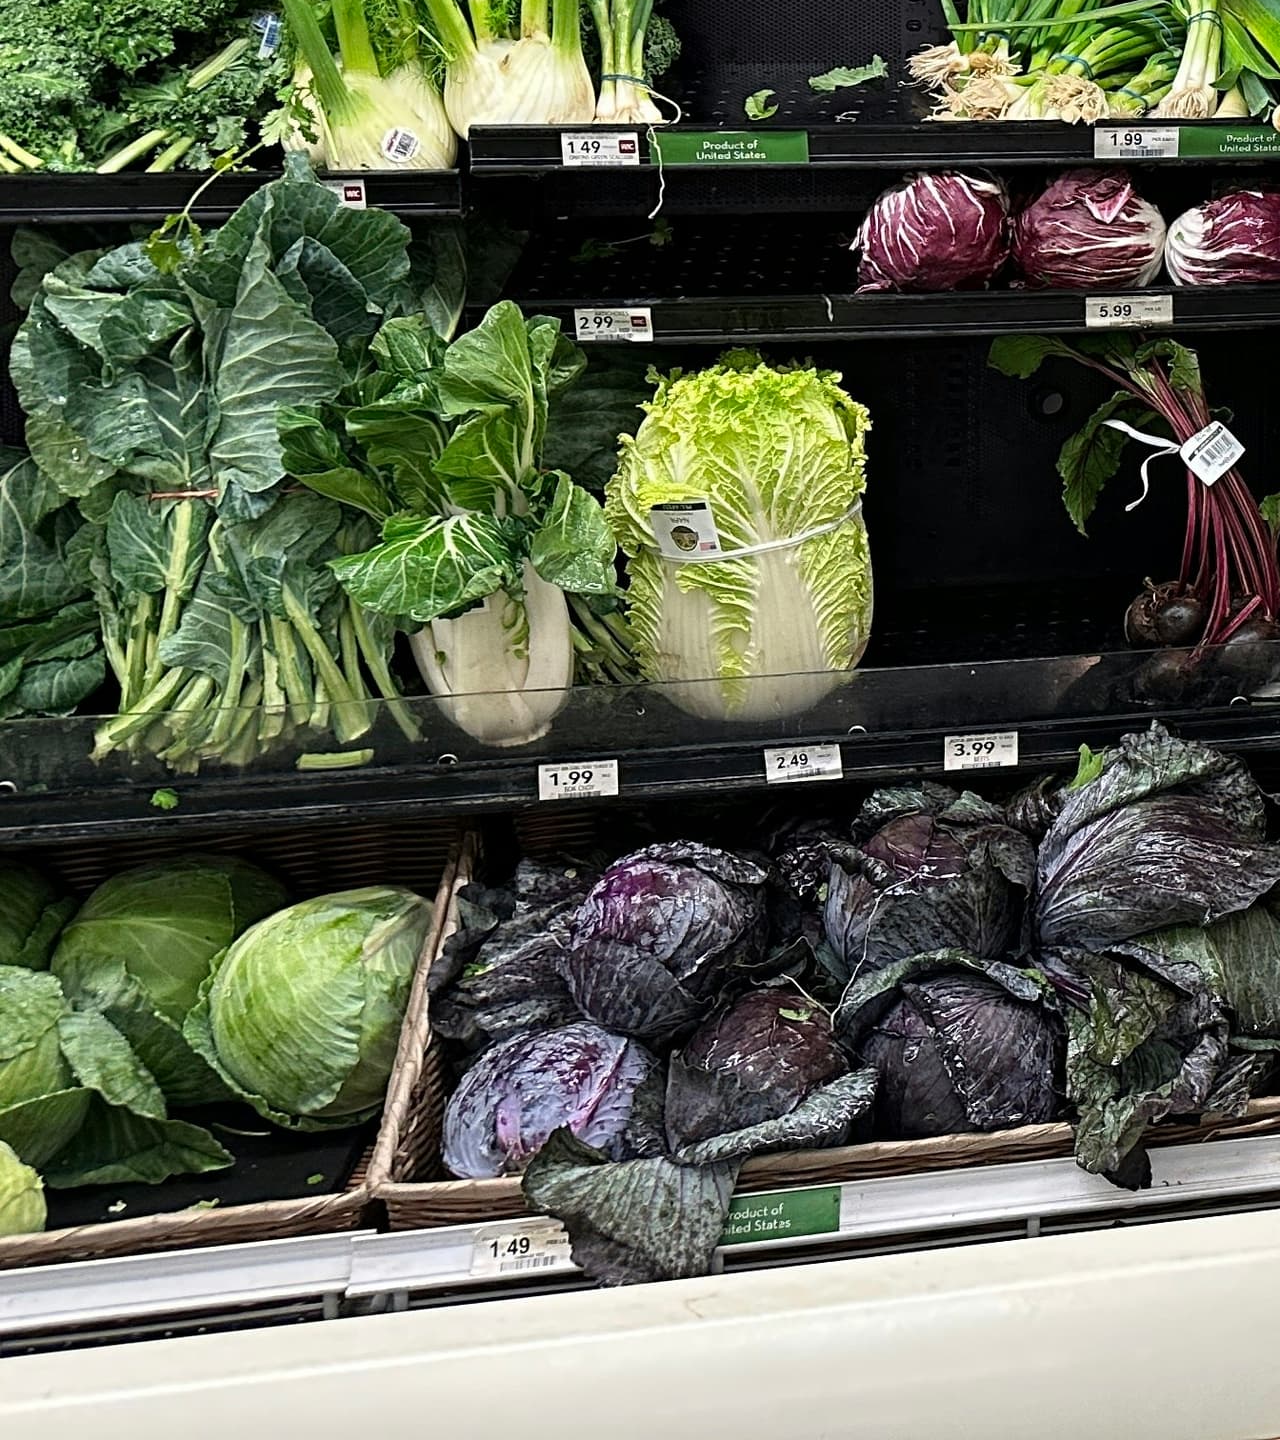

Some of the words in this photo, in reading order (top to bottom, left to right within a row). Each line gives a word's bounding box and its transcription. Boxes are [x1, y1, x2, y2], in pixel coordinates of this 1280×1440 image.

[702, 140, 745, 150] Product
[746, 140, 759, 149] of
[1110, 133, 1142, 146] 1.99
[1226, 134, 1267, 144] Product
[1268, 133, 1277, 142] of
[695, 150, 731, 160] United
[732, 150, 767, 160] States
[1219, 144, 1252, 153] United
[1099, 304, 1132, 318] 5.99
[953, 741, 995, 757] 3.99
[776, 753, 810, 769] 2.49
[549, 770, 593, 786] 1.99
[724, 1207, 769, 1224] roduct
[771, 1202, 785, 1216] of
[722, 1221, 752, 1236] nited
[754, 1219, 792, 1233] States
[489, 1236, 531, 1259] 1.49
